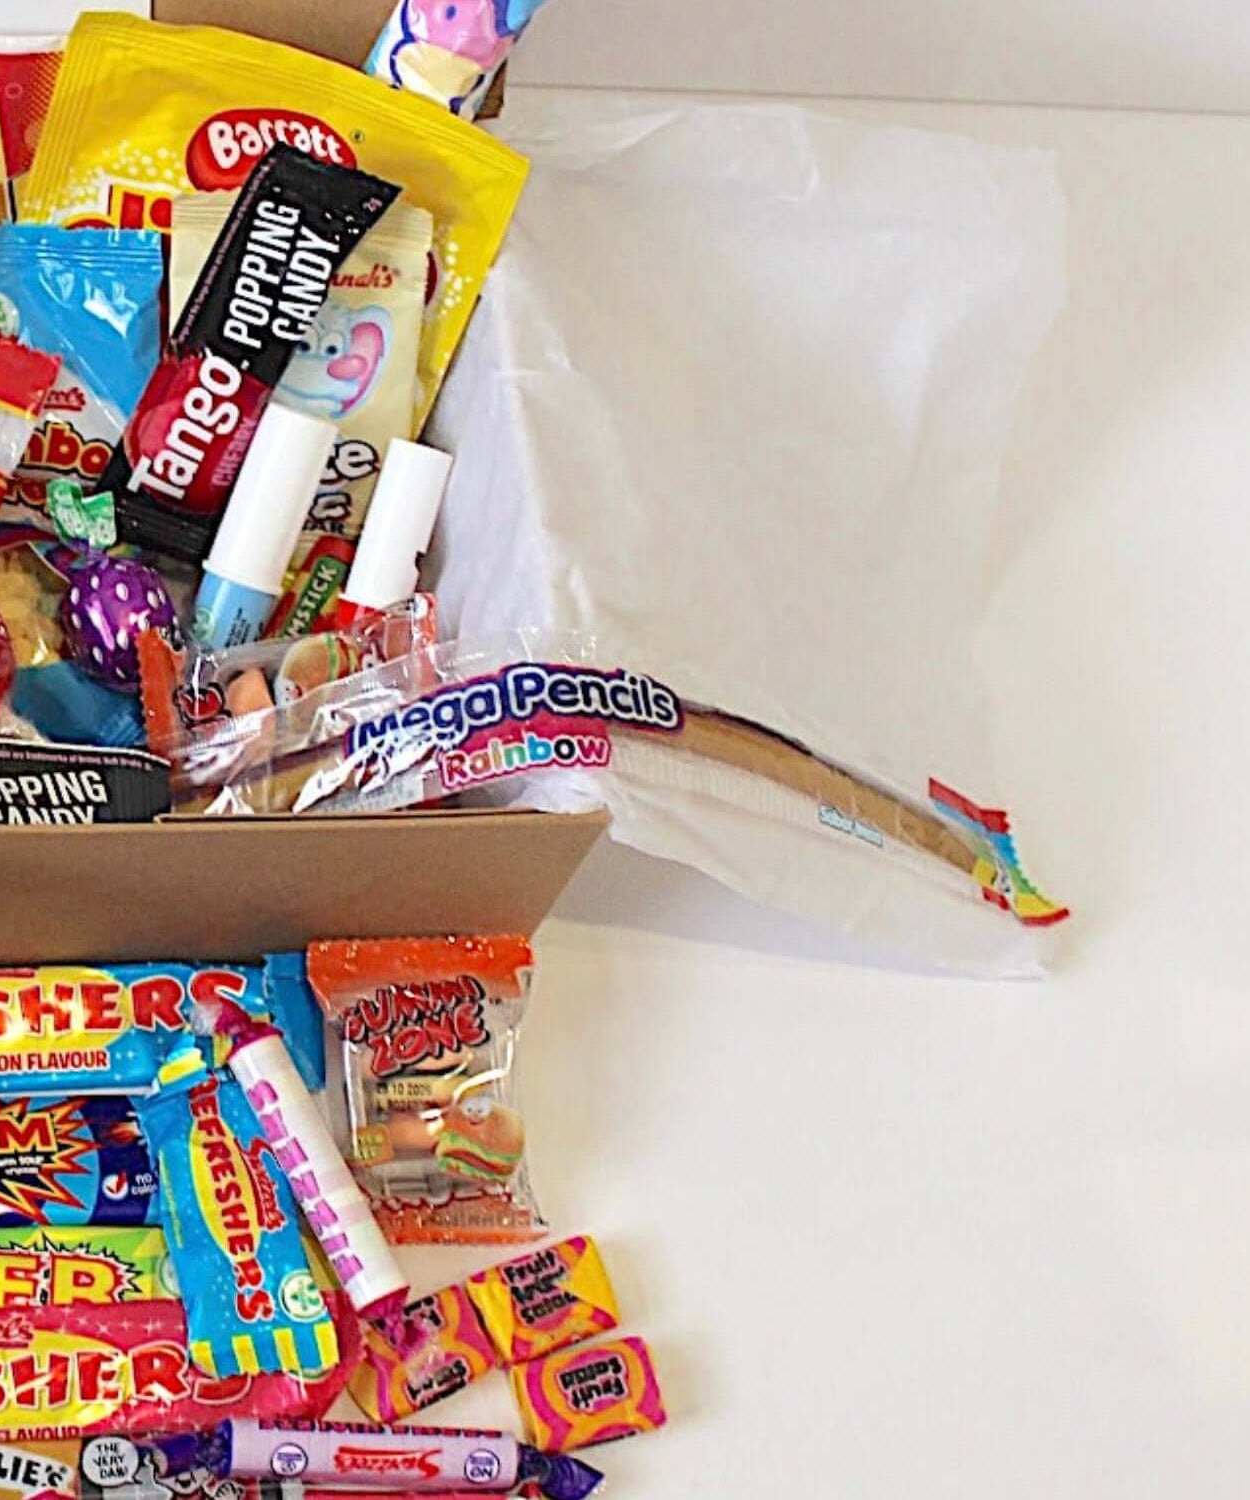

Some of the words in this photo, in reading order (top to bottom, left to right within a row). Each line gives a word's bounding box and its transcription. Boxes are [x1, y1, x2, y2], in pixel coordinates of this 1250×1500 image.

[207, 117, 345, 170] Barratt
[223, 200, 301, 349] POPPING
[271, 225, 341, 342] CANDY
[126, 349, 242, 501] Tango
[356, 683, 499, 747] Mega
[510, 668, 678, 728] Pencils
[442, 736, 610, 788] Rainbow
[27, 1051, 108, 1070] FLAVOUR
[369, 1001, 492, 1078] ZONE
[189, 1073, 275, 1321] REFRESHERS
[504, 1250, 559, 1284] Fruit
[93, 1454, 125, 1468] VERY
[96, 1443, 120, 1454] THE
